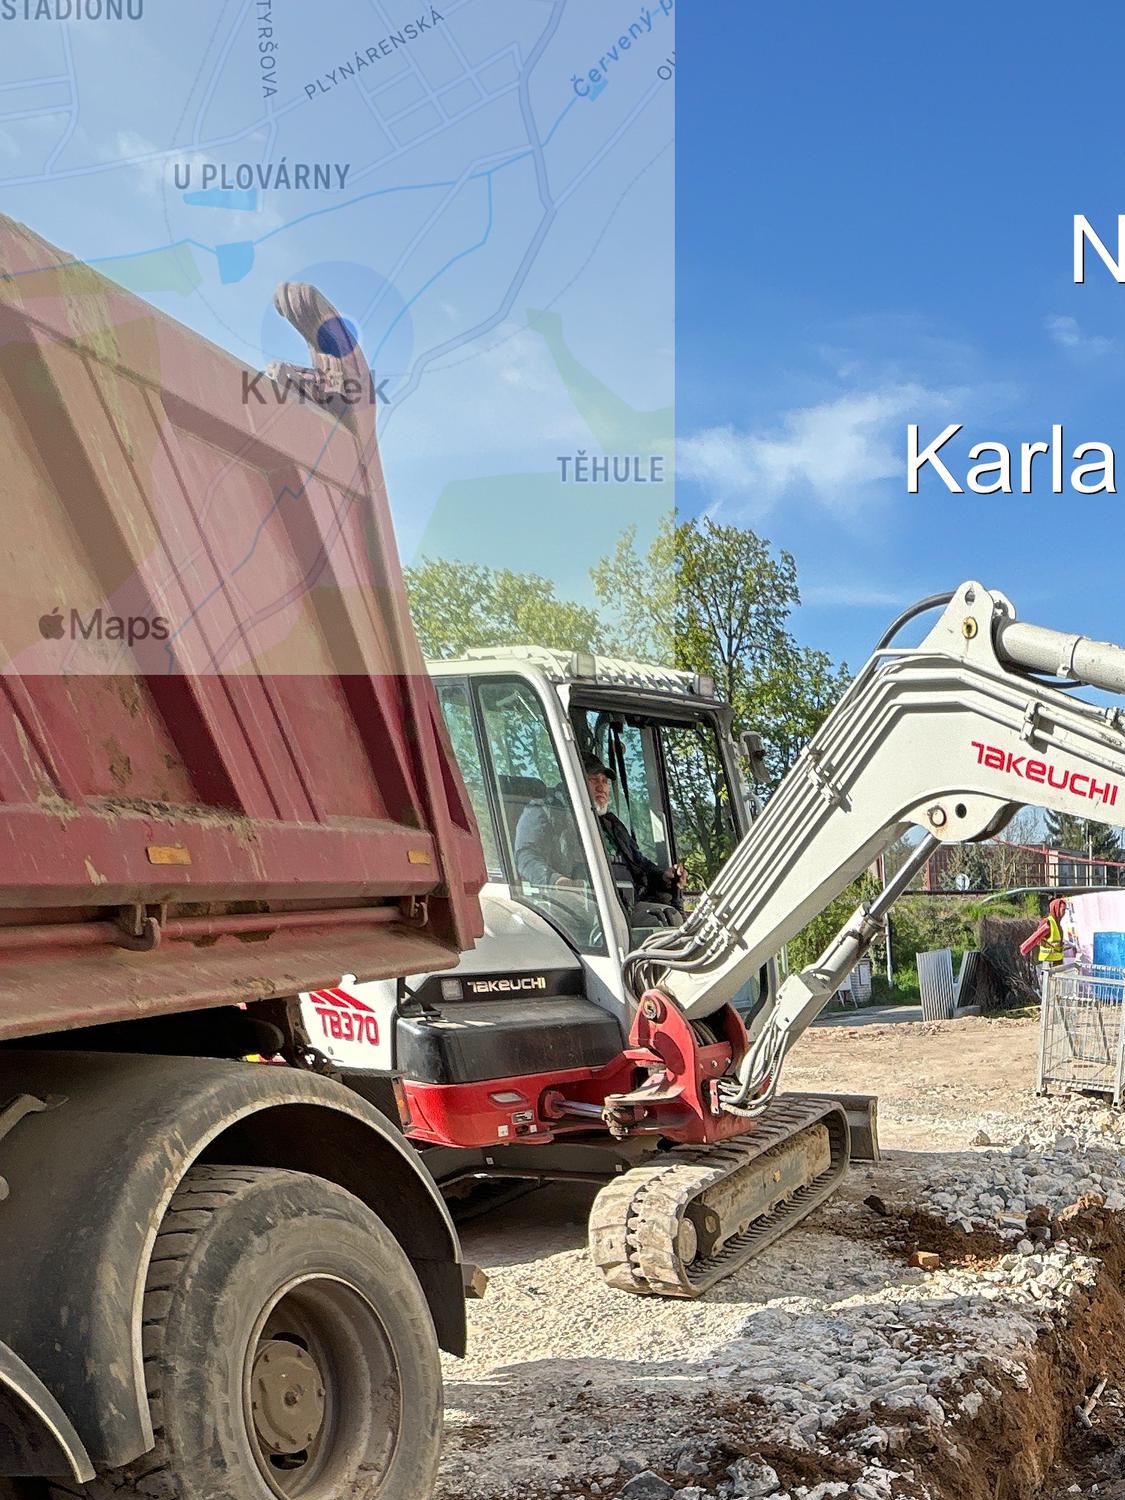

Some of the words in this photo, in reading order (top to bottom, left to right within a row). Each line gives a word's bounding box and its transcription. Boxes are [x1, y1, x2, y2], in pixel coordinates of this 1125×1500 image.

[971, 741, 1119, 806] TAKEUCHI
[467, 977, 547, 993] TAKEUCHI
[315, 1006, 380, 1046] TB370
